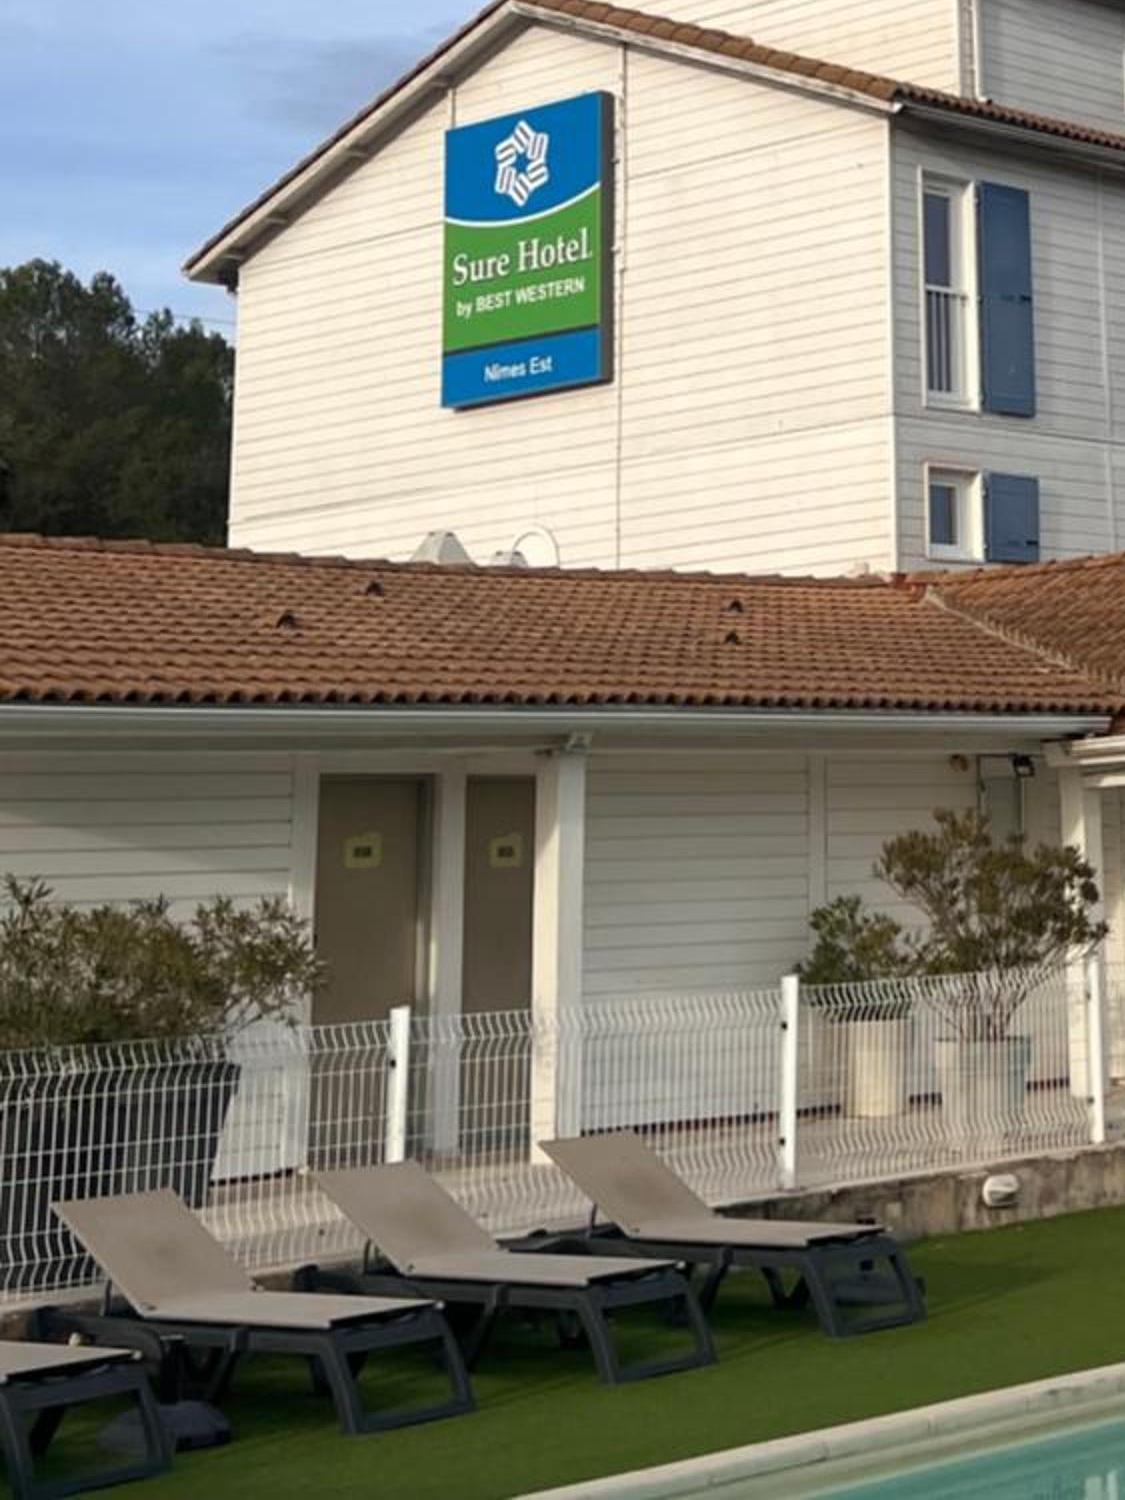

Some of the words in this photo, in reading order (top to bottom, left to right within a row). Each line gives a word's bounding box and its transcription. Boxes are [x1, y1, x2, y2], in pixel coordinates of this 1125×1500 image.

[452, 252, 510, 286] Sure
[517, 227, 590, 272] Hotel
[456, 300, 473, 319] by
[475, 290, 513, 313] BEST
[515, 276, 586, 305] WESTERN
[529, 355, 553, 375] Est
